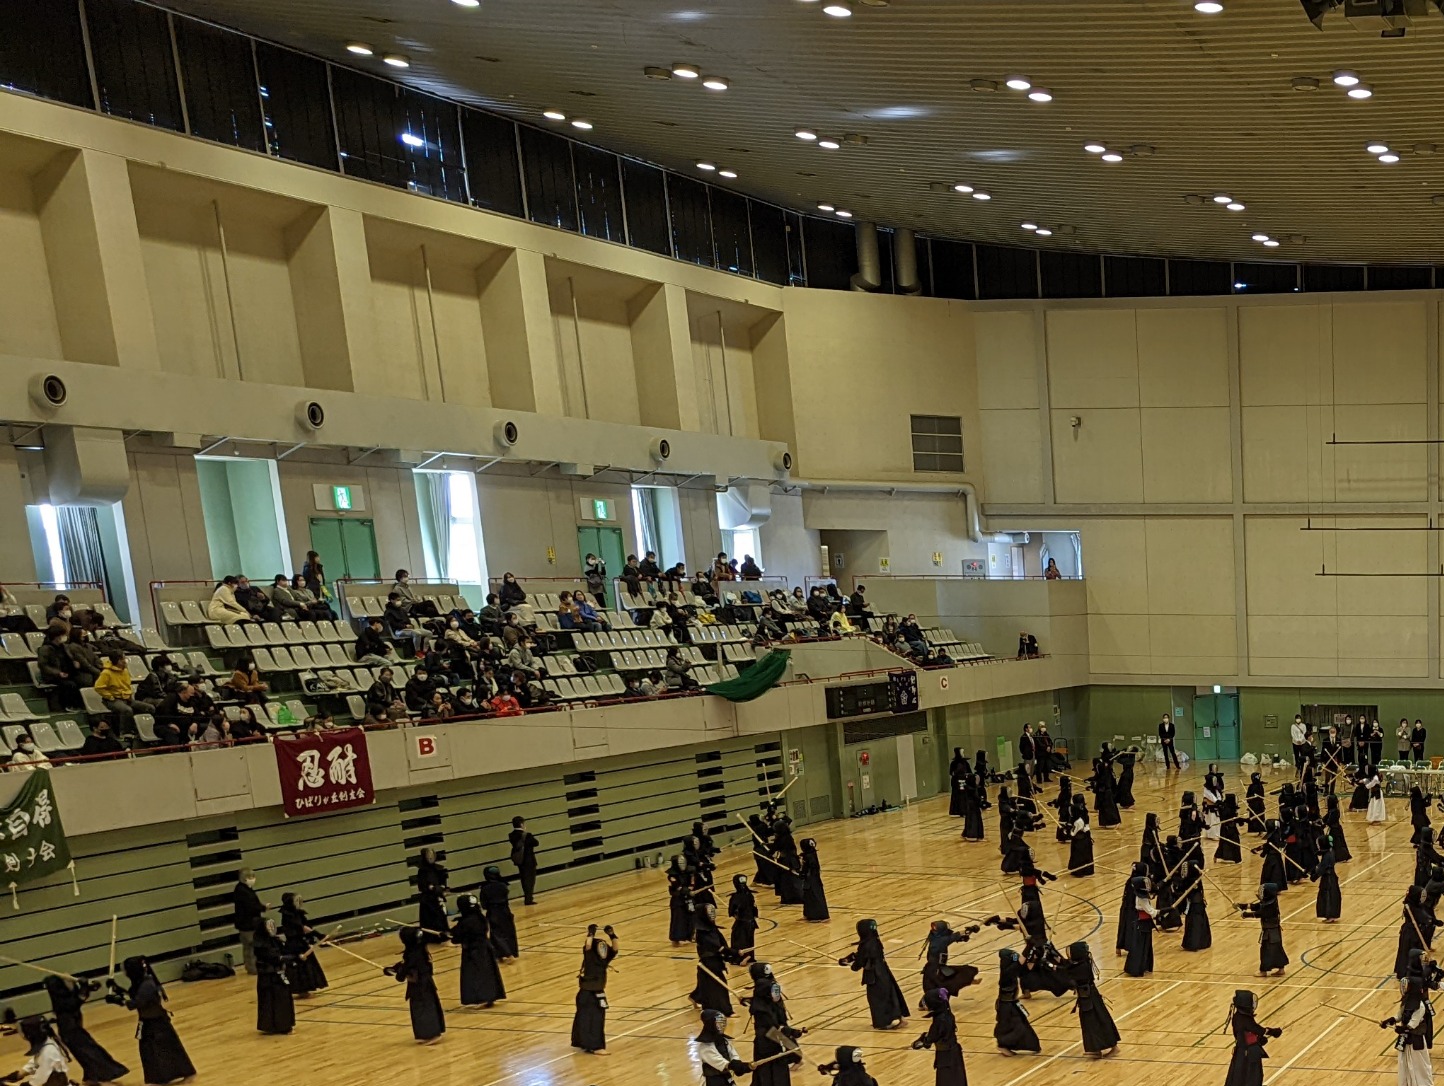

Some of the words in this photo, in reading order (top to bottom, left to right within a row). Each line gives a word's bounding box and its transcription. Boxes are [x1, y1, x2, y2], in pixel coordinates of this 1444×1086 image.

[941, 677, 947, 688] C
[418, 737, 435, 755] B
[296, 743, 357, 791] 忍耐
